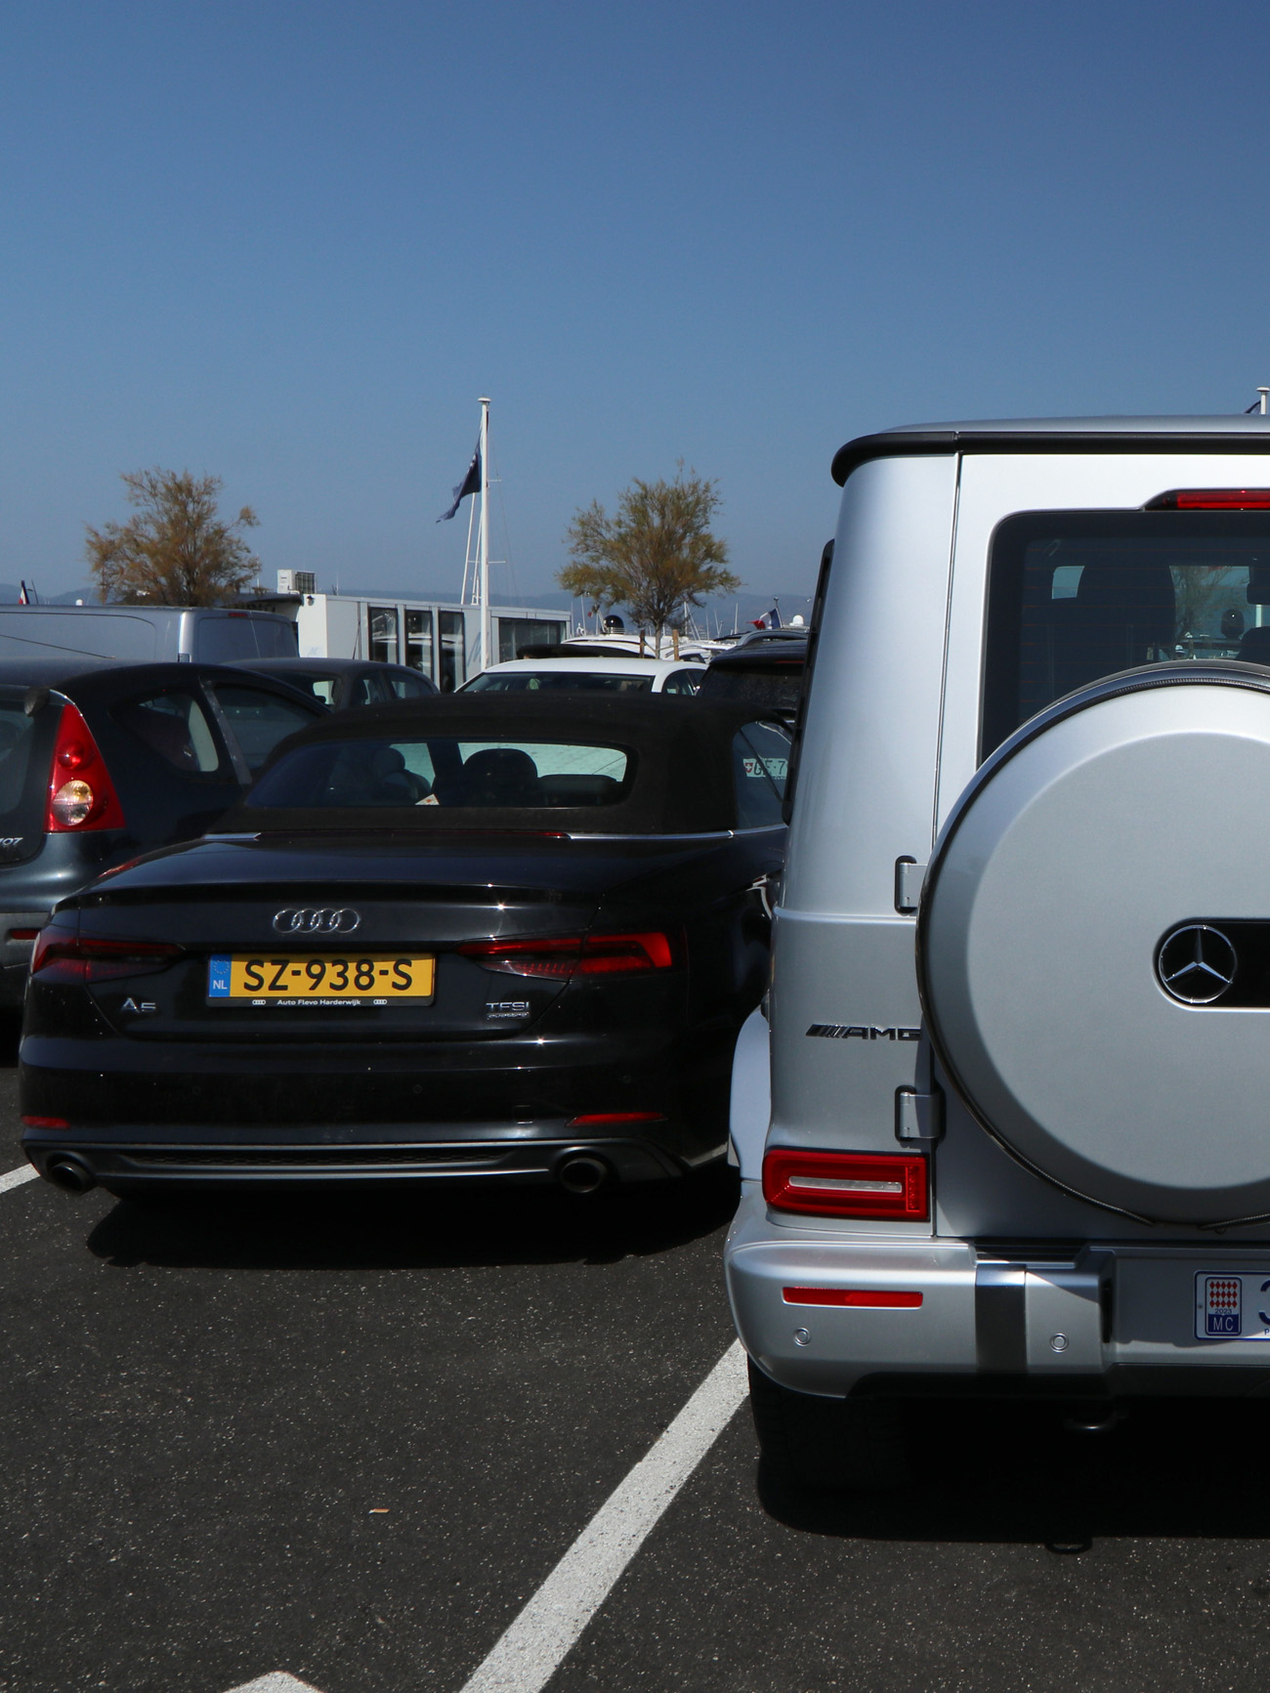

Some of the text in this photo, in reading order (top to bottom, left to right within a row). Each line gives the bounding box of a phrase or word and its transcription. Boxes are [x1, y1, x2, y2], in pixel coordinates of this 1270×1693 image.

[243, 958, 413, 991] SZ-938-S
[212, 980, 227, 990] NL
[120, 997, 157, 1014] A5
[319, 999, 361, 1007] Harderwijk
[485, 1001, 530, 1011] TFSI
[1213, 1316, 1234, 1331] MC
